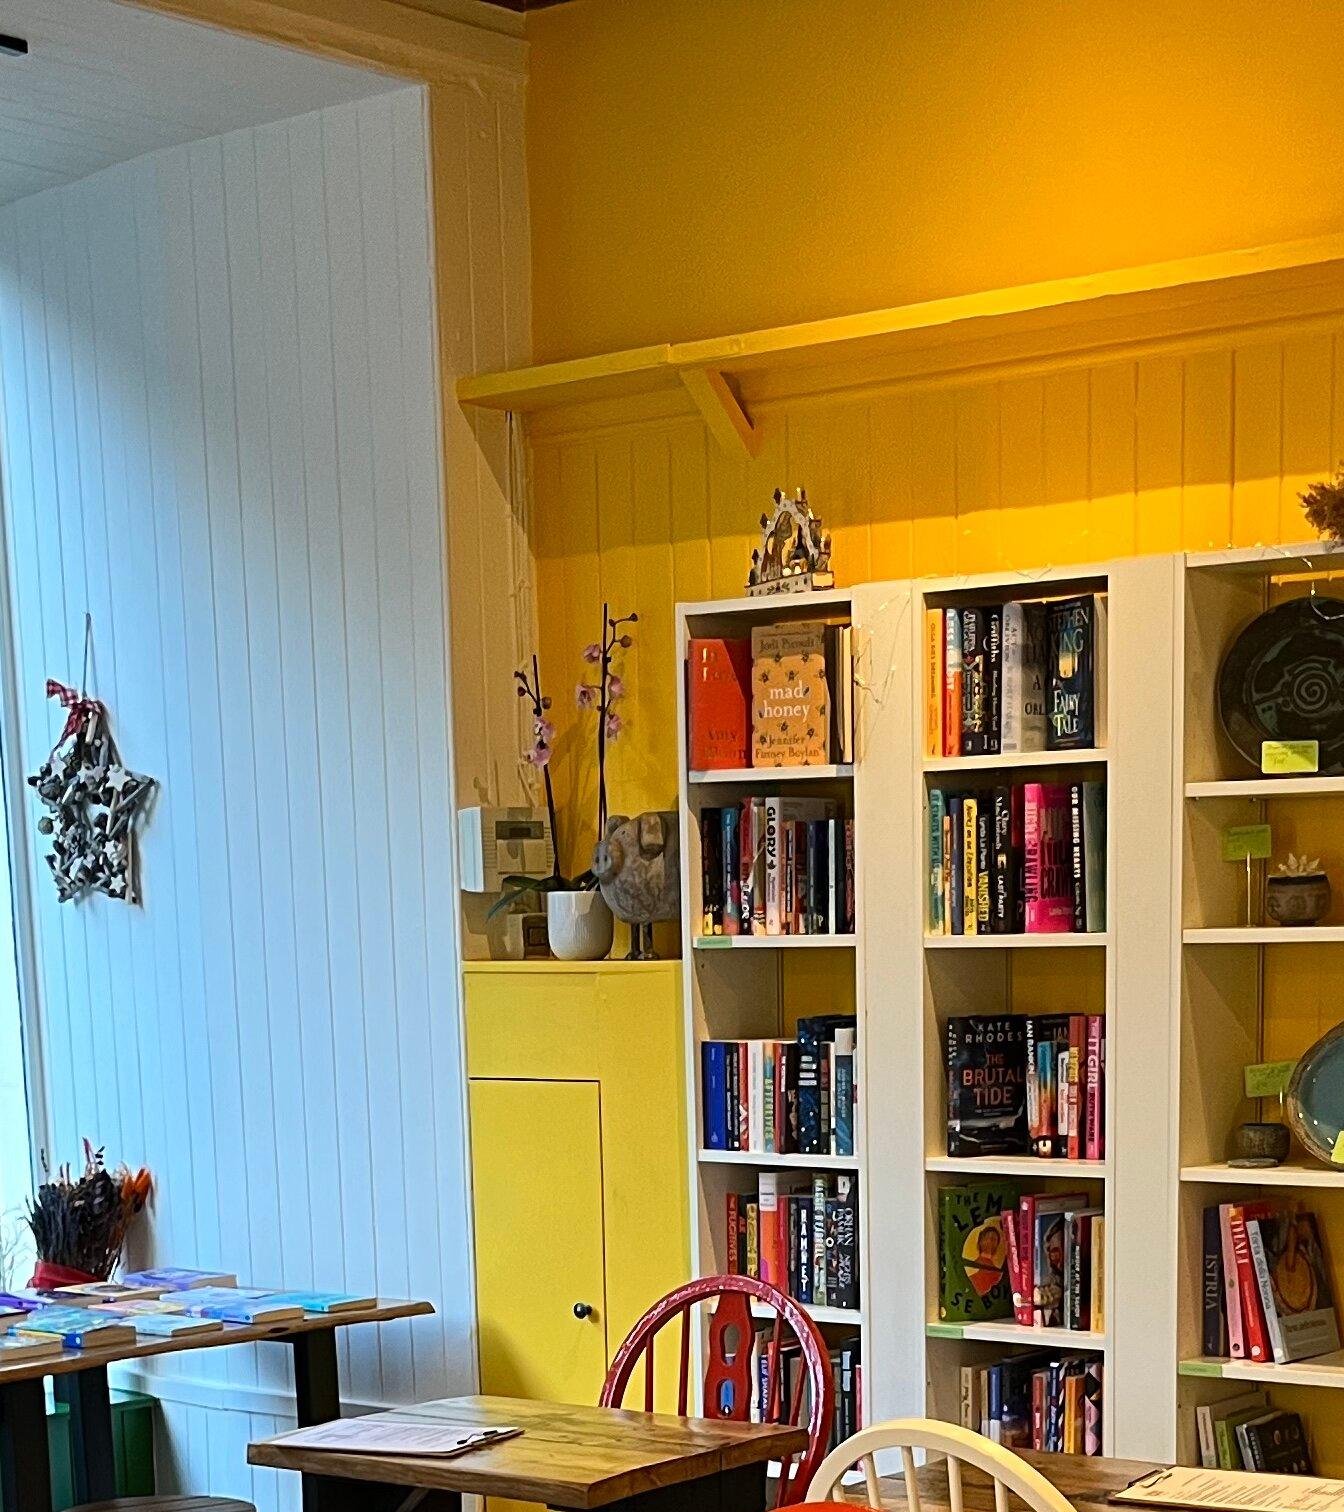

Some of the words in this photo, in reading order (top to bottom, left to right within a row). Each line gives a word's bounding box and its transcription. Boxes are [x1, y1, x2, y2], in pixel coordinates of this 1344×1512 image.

[770, 680, 805, 699] mad
[763, 701, 811, 722] honey
[767, 806, 776, 858] GLORY
[978, 871, 989, 922] VANISHED
[977, 1022, 1011, 1032] KATE
[1026, 1020, 1034, 1038] IAN
[965, 1032, 1023, 1044] RHODES
[963, 1067, 1024, 1086] BRUTAL
[974, 1087, 1015, 1106] TIDE
[801, 1209, 809, 1292] HAMNET
